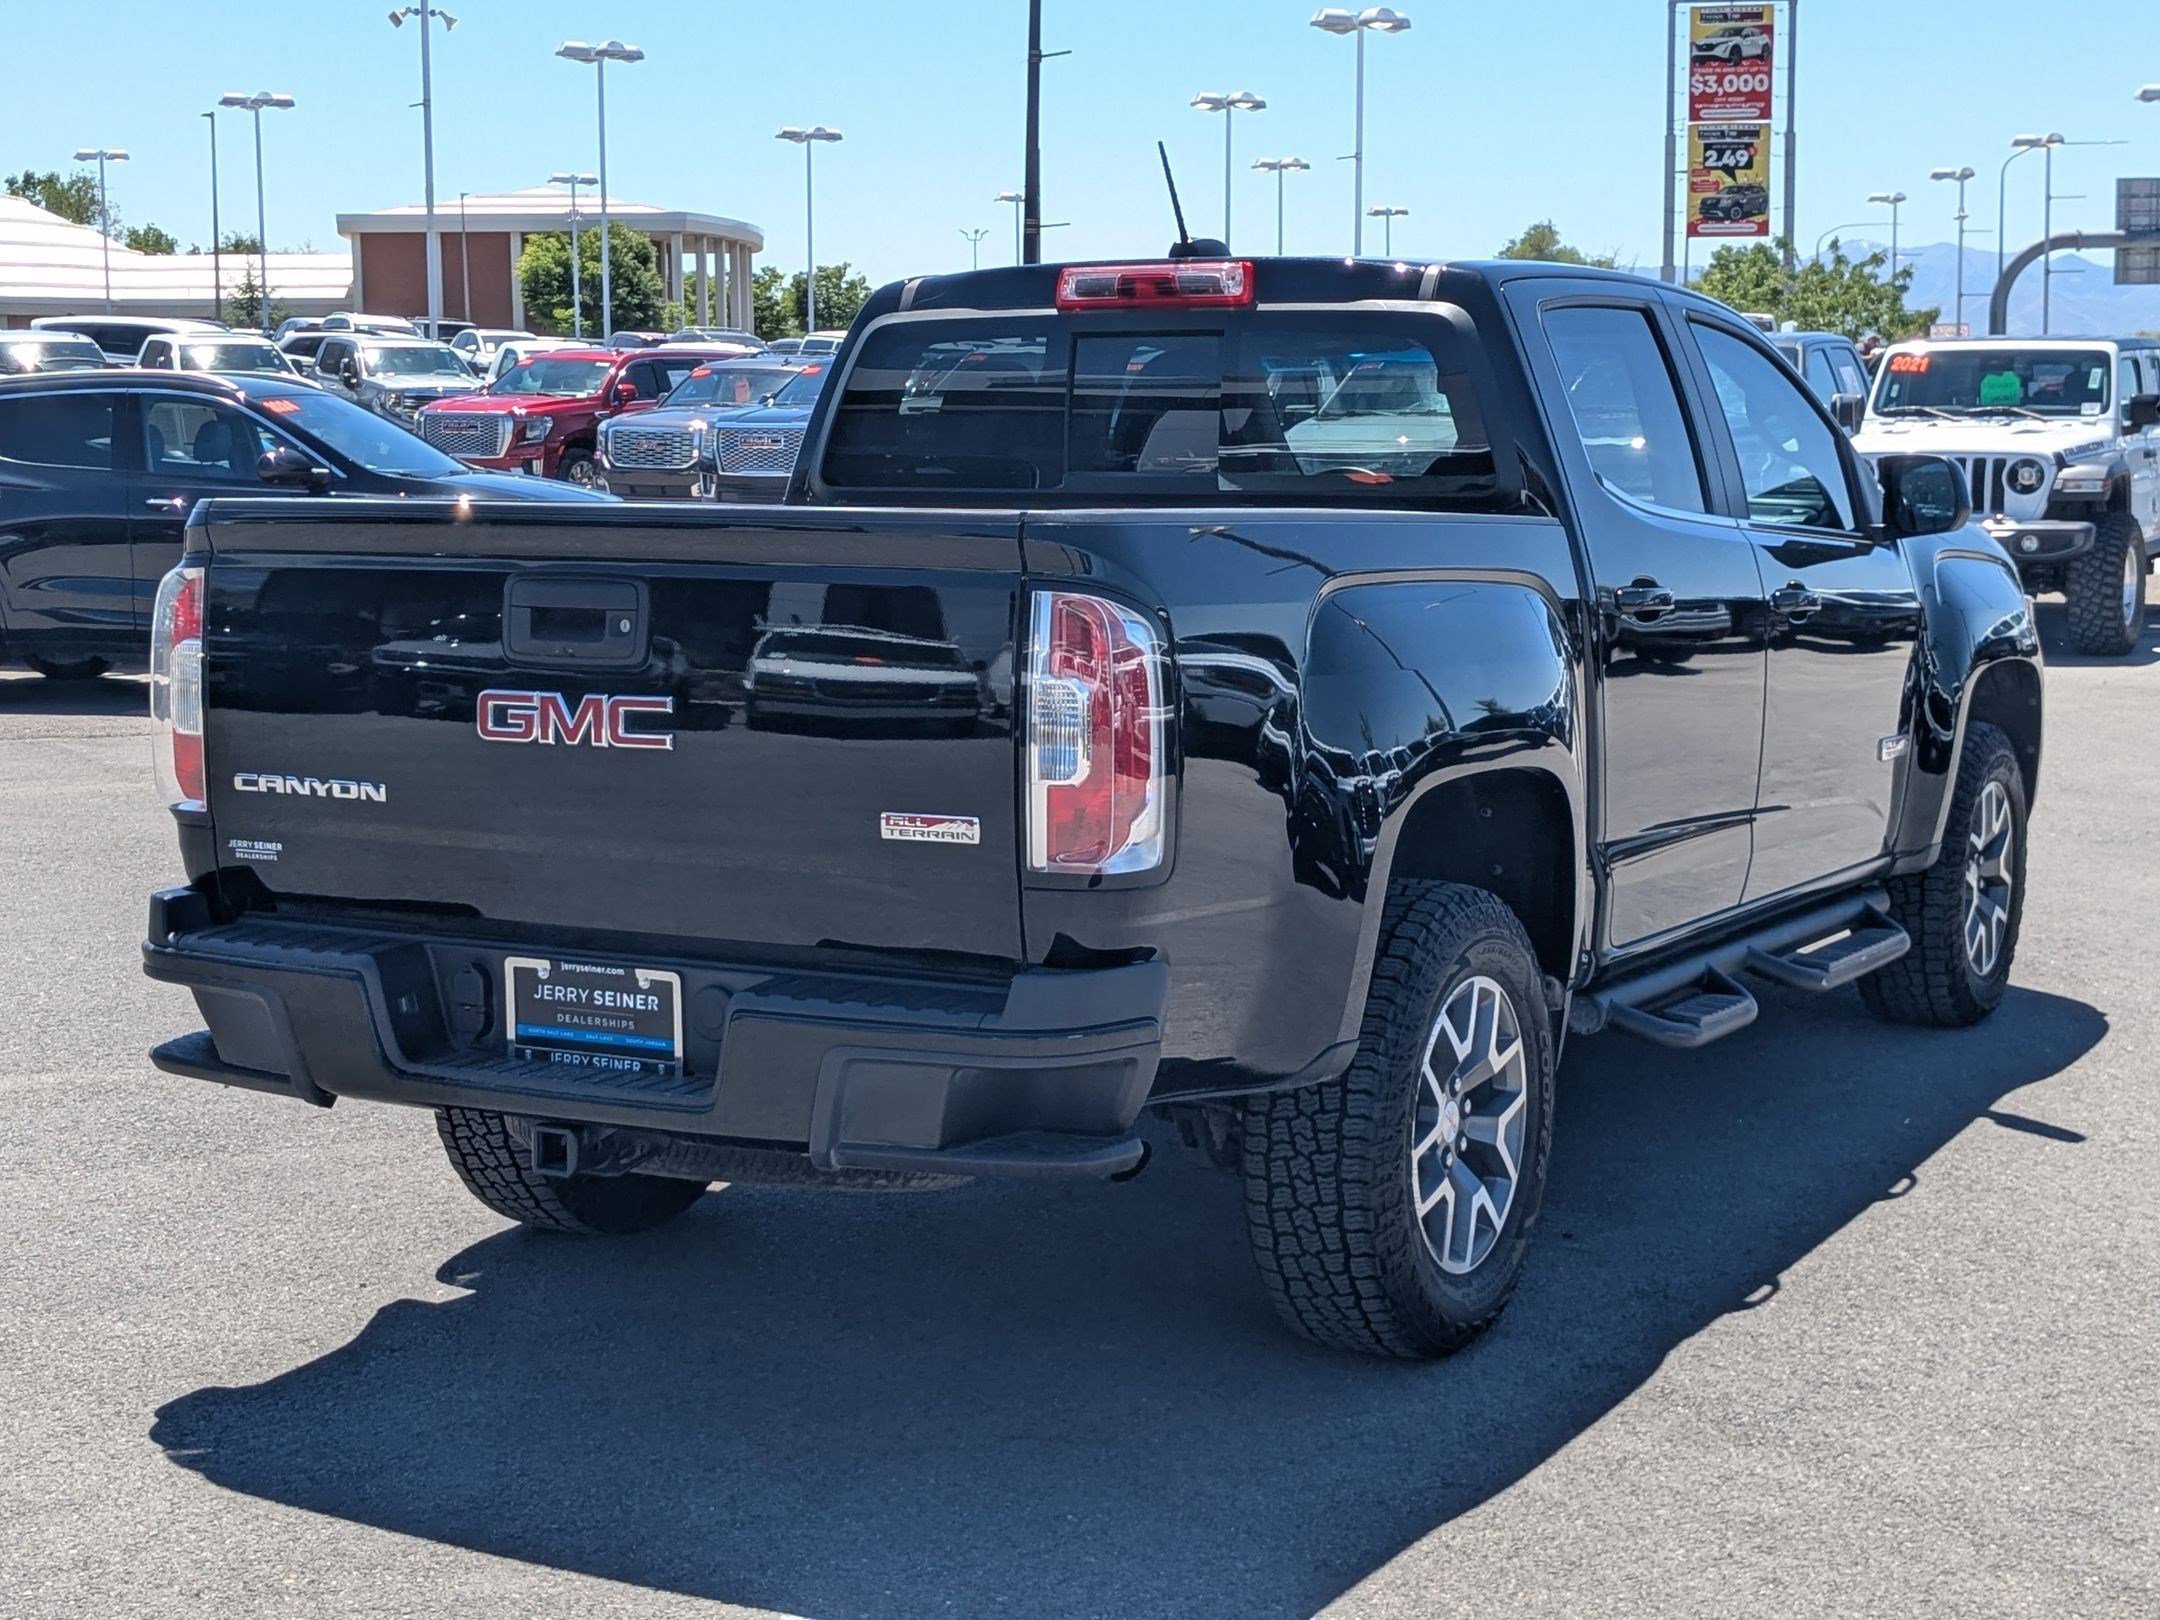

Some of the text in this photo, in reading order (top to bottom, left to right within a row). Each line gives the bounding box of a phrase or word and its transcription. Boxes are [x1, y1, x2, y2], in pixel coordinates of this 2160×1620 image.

[1691, 73, 1769, 96] $3,000
[1704, 149, 1749, 167] 2.49
[1890, 356, 1929, 373] 2021
[2063, 440, 2104, 458] RUBICON
[477, 689, 674, 750] GMC
[234, 772, 387, 802] CANYON
[890, 815, 927, 828] ALL
[885, 828, 975, 841] TERRAIN
[228, 839, 283, 851] JERRY SEINER
[235, 852, 278, 861] DEALERSHIPS
[561, 961, 625, 976] jerryseiner.com
[533, 984, 659, 1011] JERRY SEINER
[557, 1013, 635, 1030] DEALERSHIPS
[592, 1057, 641, 1072] SEINER
